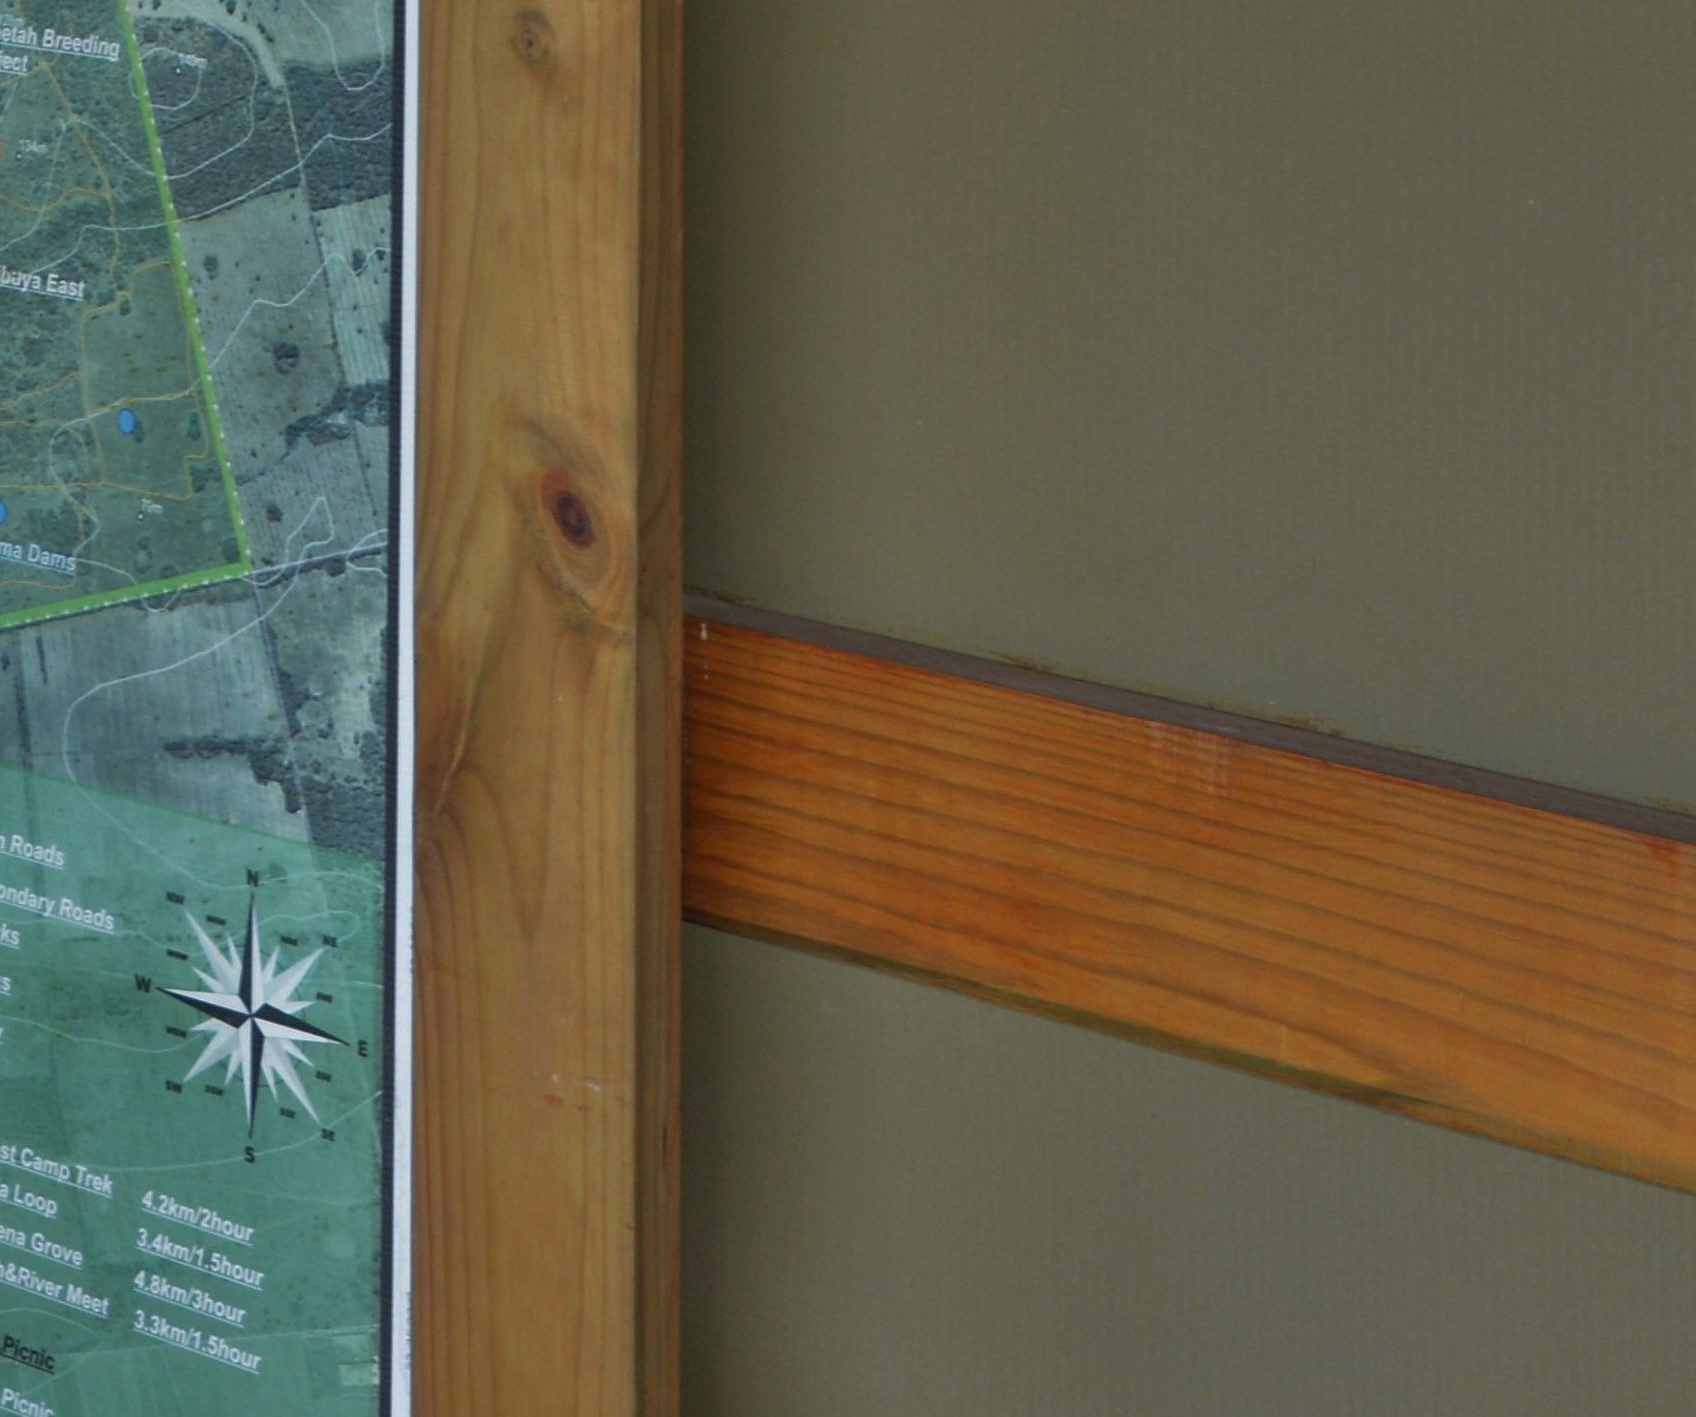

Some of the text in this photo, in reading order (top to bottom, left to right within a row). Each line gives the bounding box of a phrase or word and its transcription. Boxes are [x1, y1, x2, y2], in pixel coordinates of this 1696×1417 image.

[41, 26, 120, 61] Breeding
[46, 273, 85, 298] East
[28, 544, 78, 571] Dams
[10, 835, 65, 865] Roads
[247, 869, 259, 887] N
[59, 898, 114, 929] Roads
[135, 975, 151, 993] W
[357, 1041, 368, 1058] E
[20, 1146, 73, 1181] Camp
[76, 1164, 114, 1192] Trek
[244, 1146, 256, 1163] S
[13, 1183, 59, 1217] Loop
[143, 1191, 254, 1241] 4.2km/2hour
[31, 1232, 83, 1265] Grove
[136, 1230, 265, 1288] 3.4km/1.5hour
[65, 1286, 109, 1315] Meet
[135, 1271, 246, 1325] 4.8km/3hour
[133, 1310, 262, 1370] 3.3km/1.5hour
[0, 1388, 54, 1417] Picnic
